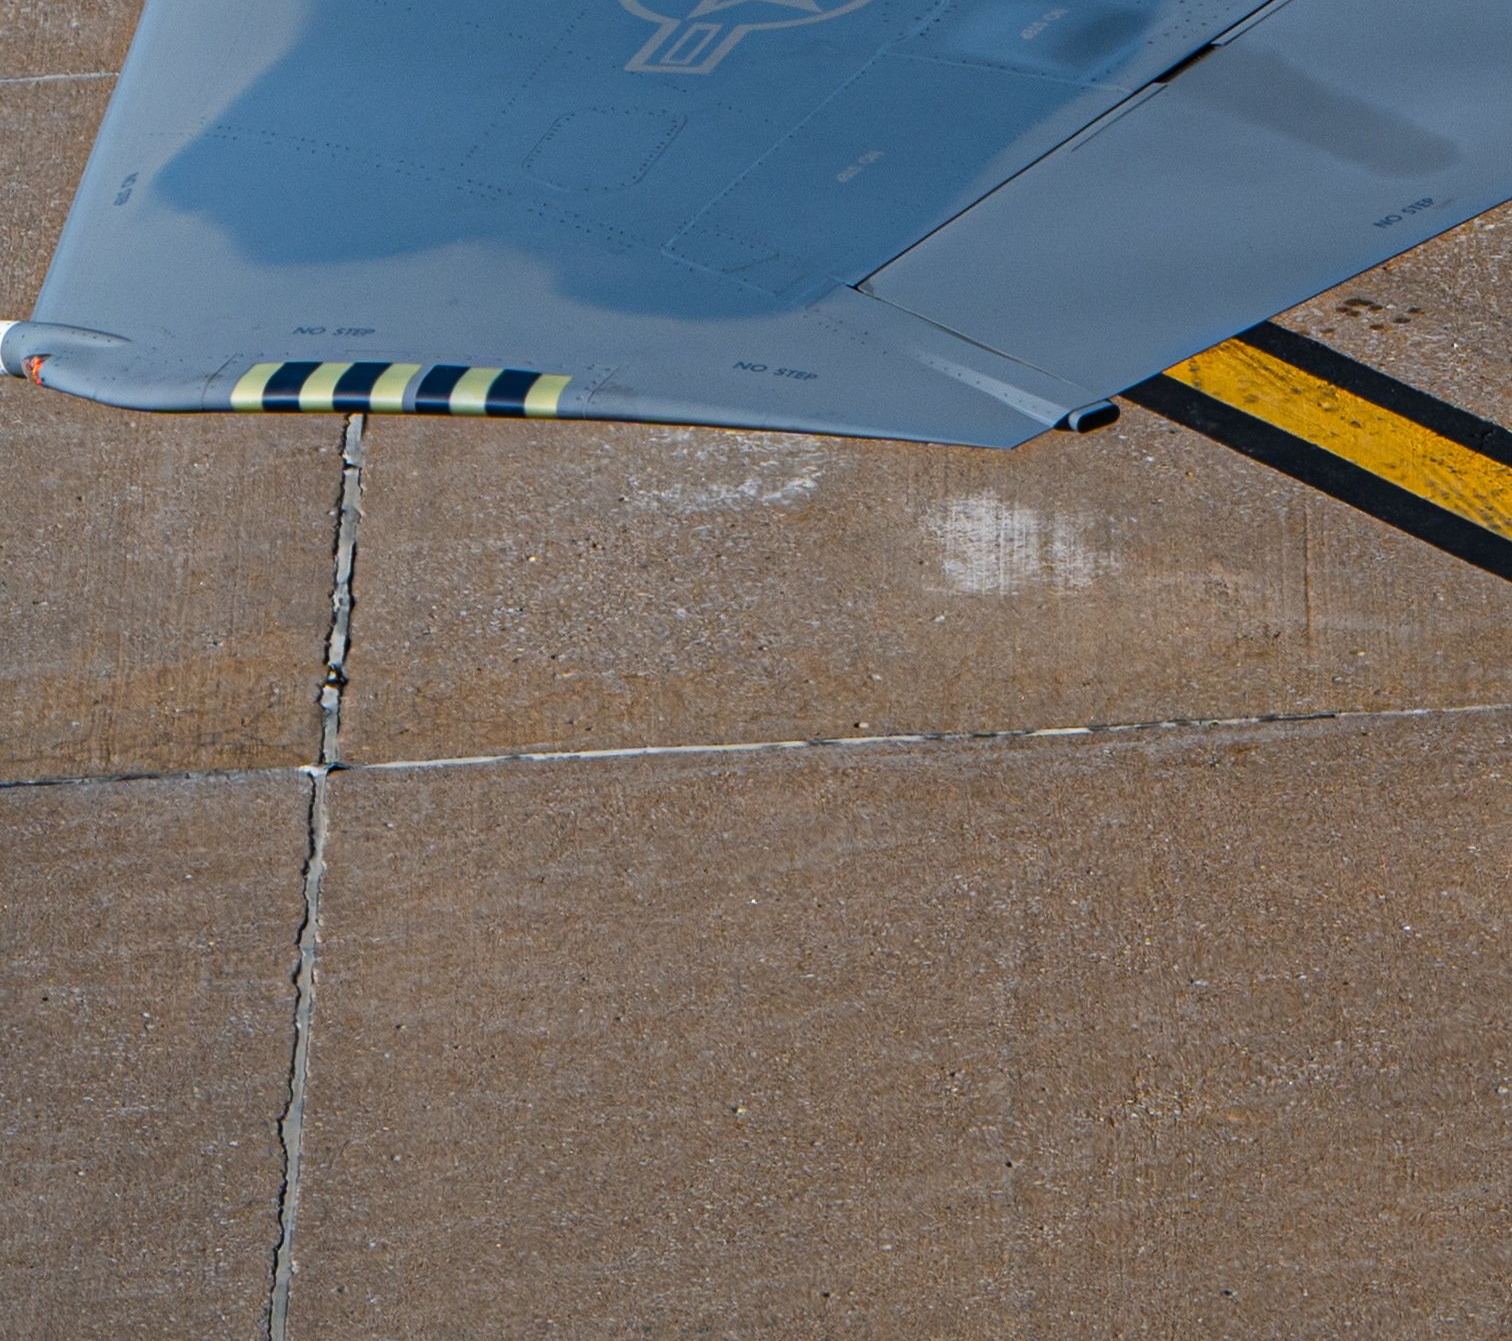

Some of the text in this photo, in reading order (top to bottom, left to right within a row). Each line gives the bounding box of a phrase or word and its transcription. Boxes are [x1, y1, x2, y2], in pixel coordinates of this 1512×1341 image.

[1372, 213, 1403, 229] NO
[292, 325, 377, 339] NO STEP
[732, 360, 819, 382] NO STEP
